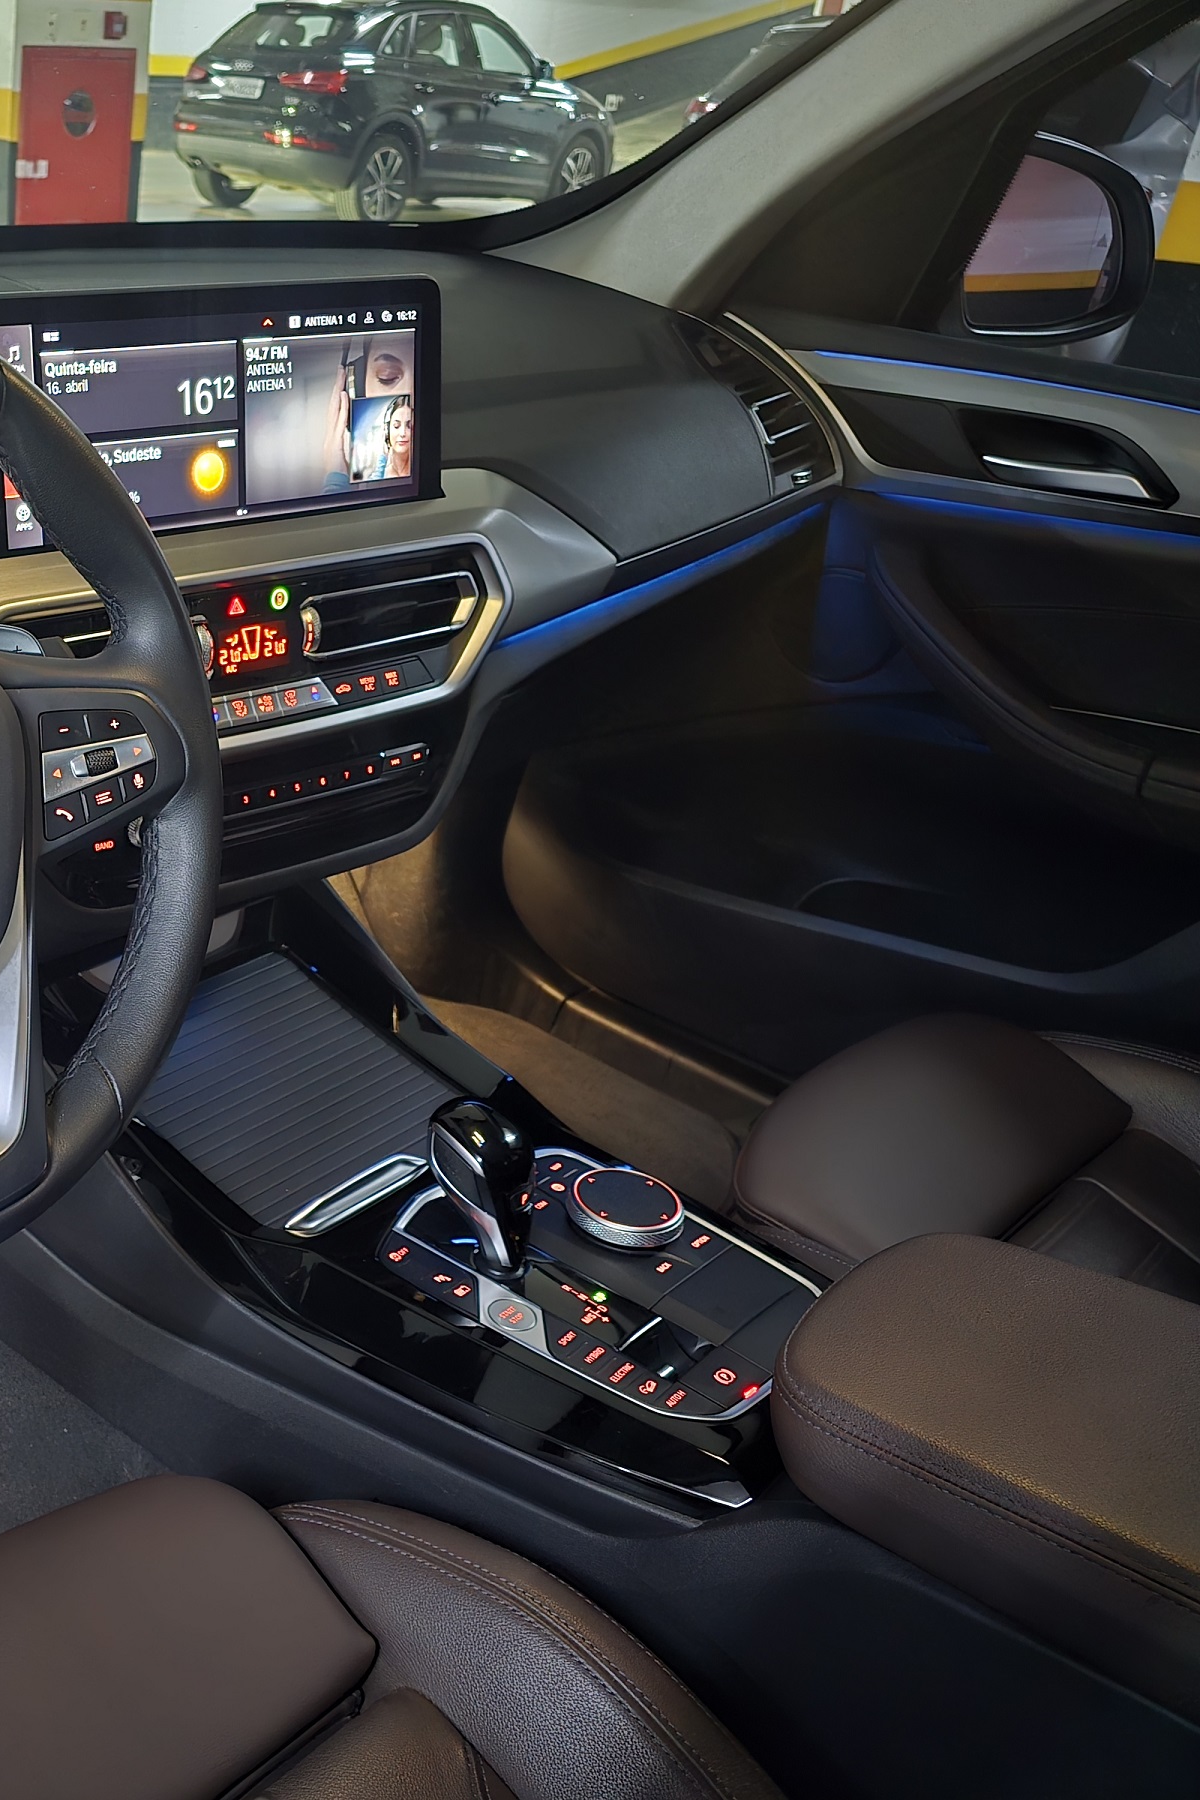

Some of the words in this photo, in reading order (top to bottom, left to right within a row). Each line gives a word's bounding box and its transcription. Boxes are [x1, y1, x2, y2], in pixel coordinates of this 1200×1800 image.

[304, 315, 338, 327] ANTENA
[396, 310, 417, 321] 16:12
[245, 348, 269, 361] 94.7
[270, 346, 288, 359] FM
[45, 359, 117, 378] Quinta-feira
[246, 363, 286, 377] ANTENA
[286, 362, 292, 373] 1
[45, 382, 62, 395] 16.
[65, 379, 89, 394] abril
[246, 379, 286, 393] ANTENA
[286, 378, 293, 389] 1
[113, 446, 162, 464] Sudeste
[269, 789, 276, 797] 4
[294, 783, 301, 792] 5
[243, 795, 249, 804] 3
[94, 840, 114, 852] BAND
[557, 1330, 577, 1346] SPORT
[583, 1346, 605, 1364] HYBRID
[609, 1362, 635, 1383] ELECTRIC
[665, 1392, 682, 1408] AUTO
